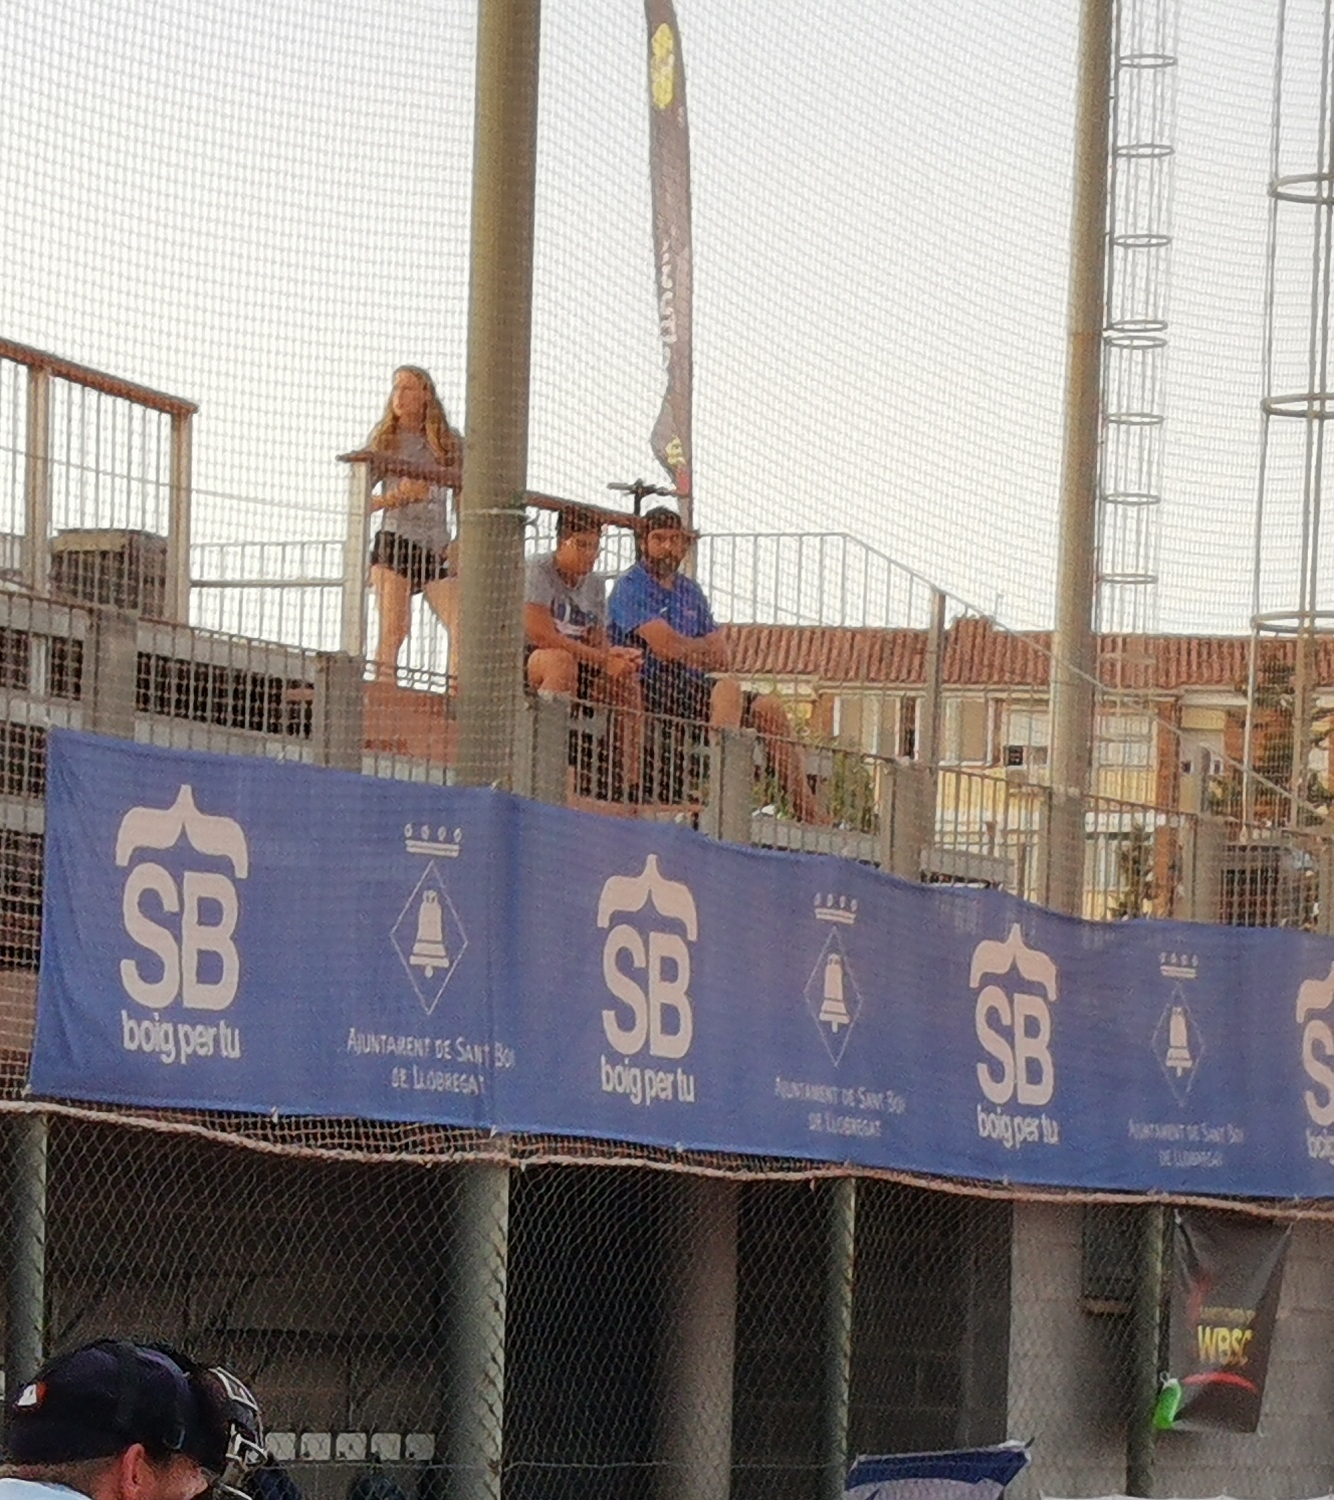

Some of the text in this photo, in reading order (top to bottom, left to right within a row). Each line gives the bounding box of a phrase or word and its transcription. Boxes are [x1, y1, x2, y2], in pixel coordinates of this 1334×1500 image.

[120, 862, 240, 1010] SB
[601, 925, 693, 1058] SB
[121, 1009, 241, 1065] boig per tu
[435, 1038, 452, 1060] DE
[975, 985, 1055, 1105] SB
[601, 1053, 695, 1107] boig per tu
[977, 1103, 1059, 1150] boig per tu
[1197, 1325, 1254, 1366] WBSC
